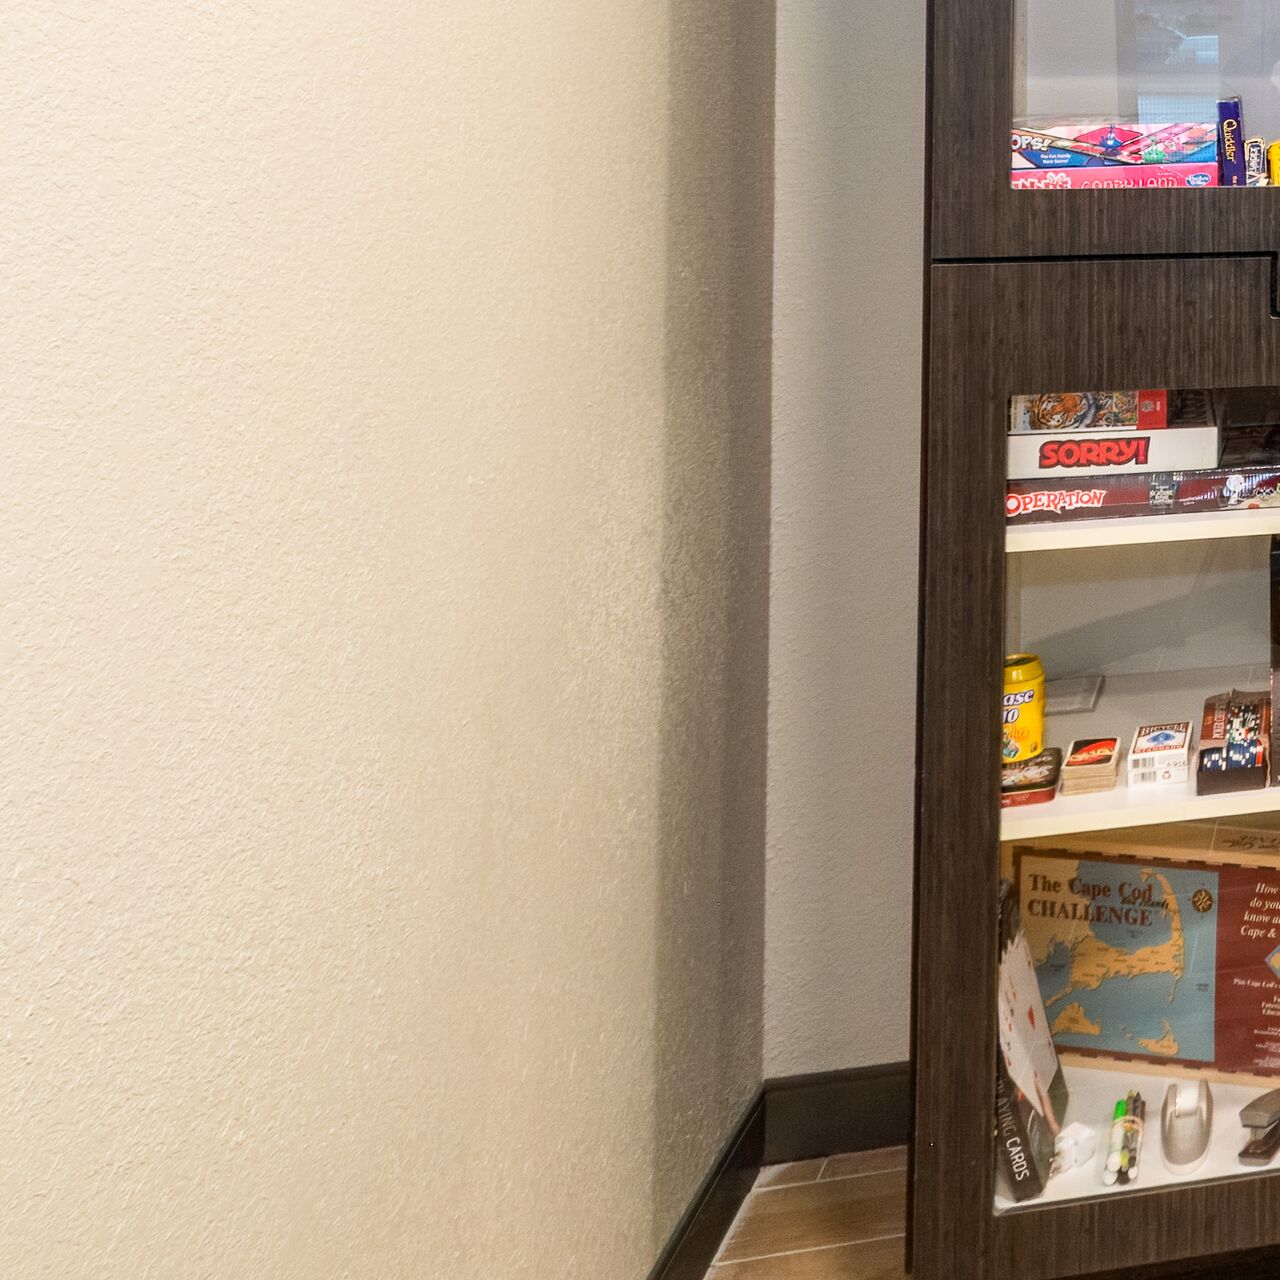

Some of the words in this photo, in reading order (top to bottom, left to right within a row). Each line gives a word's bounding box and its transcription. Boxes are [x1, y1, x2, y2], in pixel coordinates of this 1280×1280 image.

[1223, 118, 1237, 162] Quiddler
[1040, 438, 1149, 467] SORRY!
[1007, 490, 1106, 517] OPERATION
[1140, 722, 1186, 736] BICYCLE
[1028, 873, 1061, 893] The
[1067, 878, 1112, 901] Cape
[1118, 881, 1153, 900] Cod
[1255, 882, 1279, 894] How
[1027, 898, 1153, 927] CHALLENGE
[1249, 897, 1262, 908] do
[1243, 911, 1271, 922] know
[1240, 925, 1266, 939] Cape
[1267, 928, 1277, 938] &
[1005, 1137, 1030, 1182] CARDS
